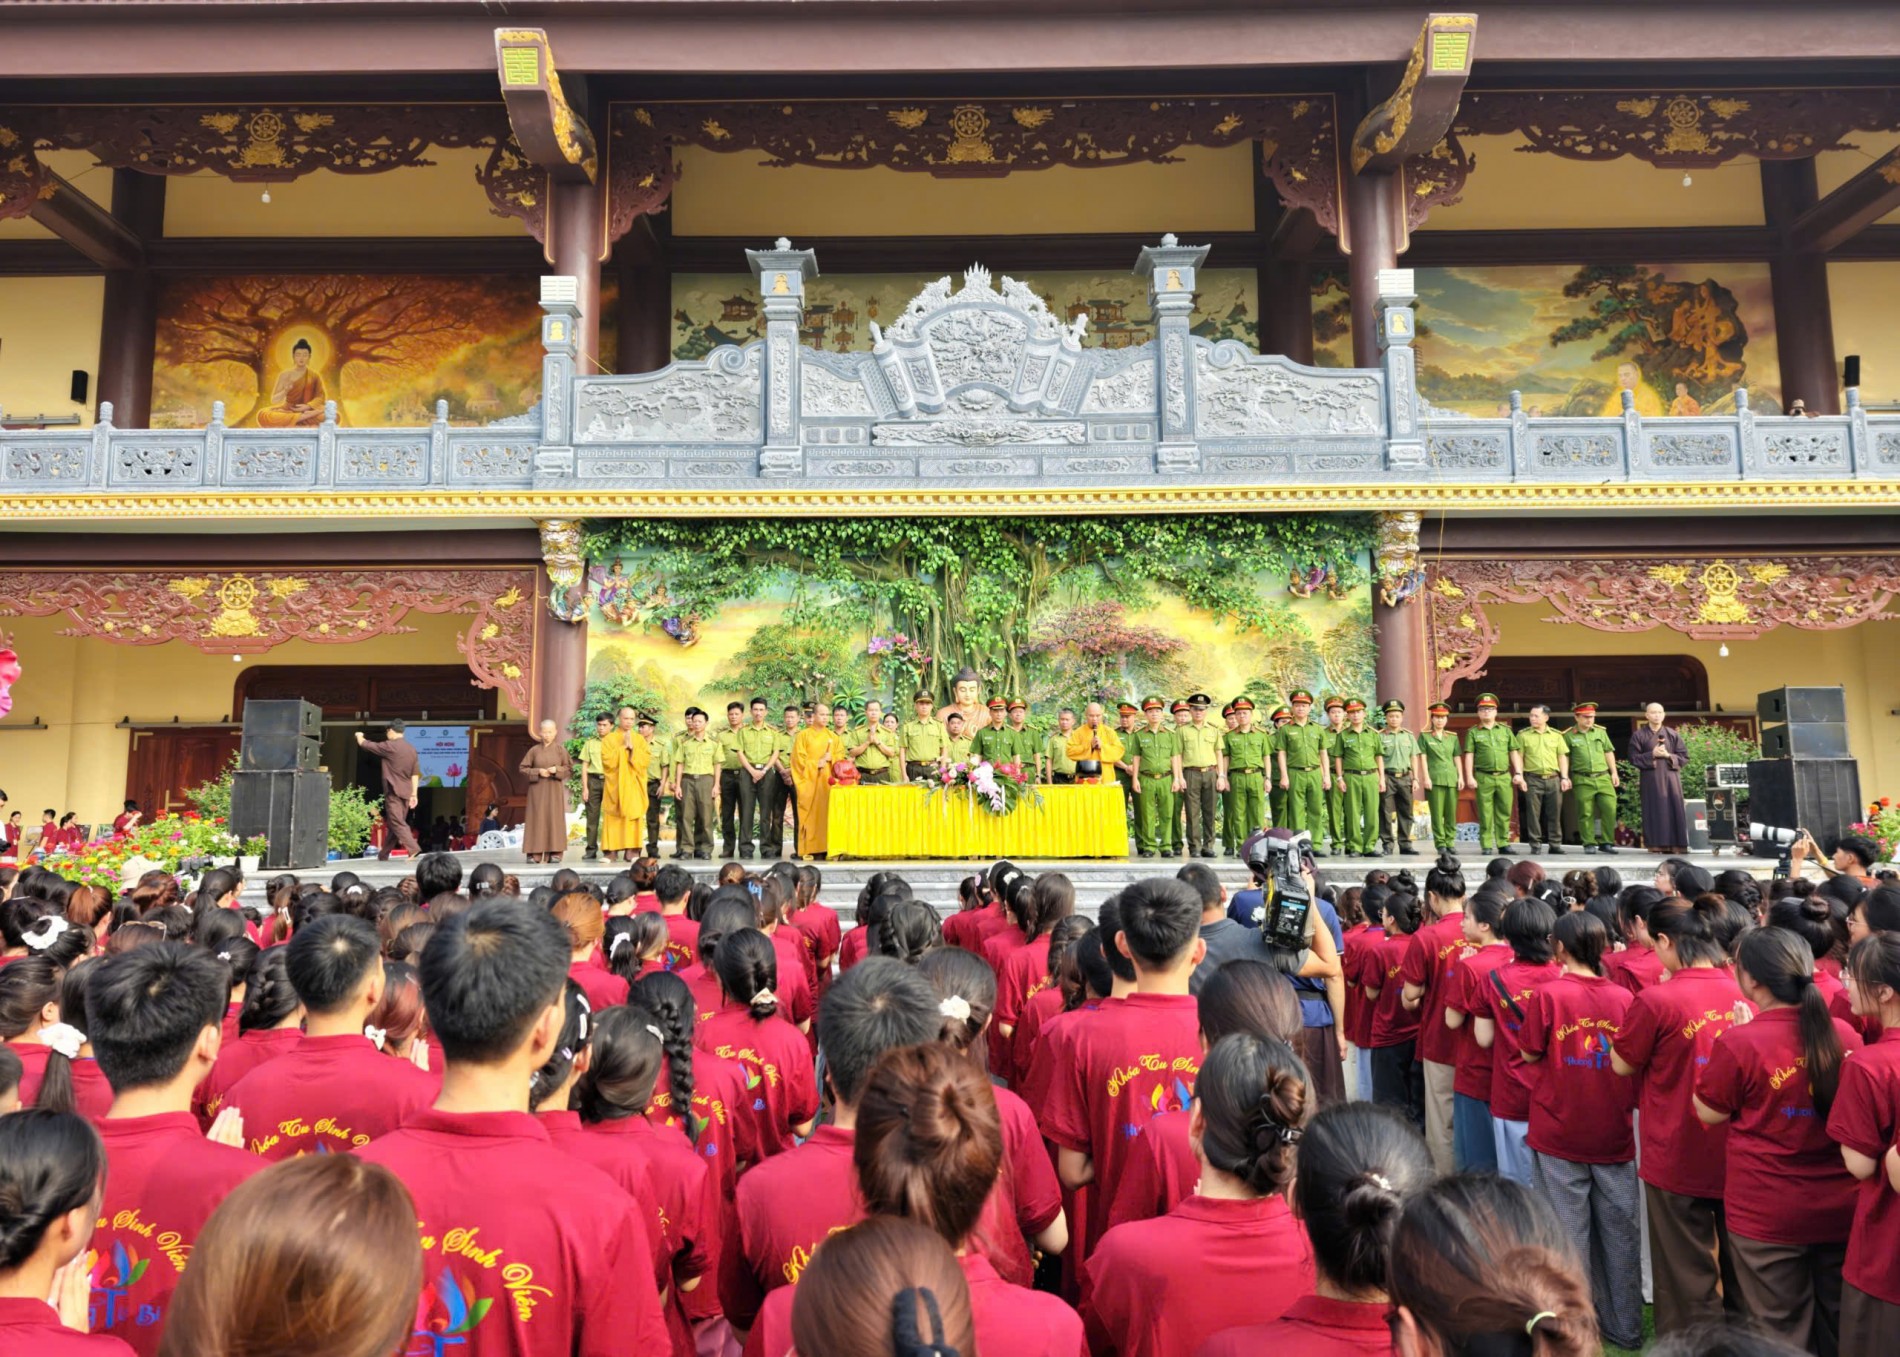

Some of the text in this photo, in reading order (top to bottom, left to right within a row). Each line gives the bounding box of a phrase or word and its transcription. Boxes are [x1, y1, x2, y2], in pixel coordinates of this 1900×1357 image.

[1107, 1053, 1200, 1097] Khóa Tu Sin
[1770, 1067, 1797, 1090] Khóa
[691, 1089, 710, 1105] inh
[278, 1117, 310, 1137] Tu
[314, 1117, 352, 1140] Sinh
[113, 1208, 157, 1238] Sinh
[442, 1227, 503, 1268] Sinh
[502, 1263, 553, 1322] Viên
[782, 1242, 816, 1285] Kh
